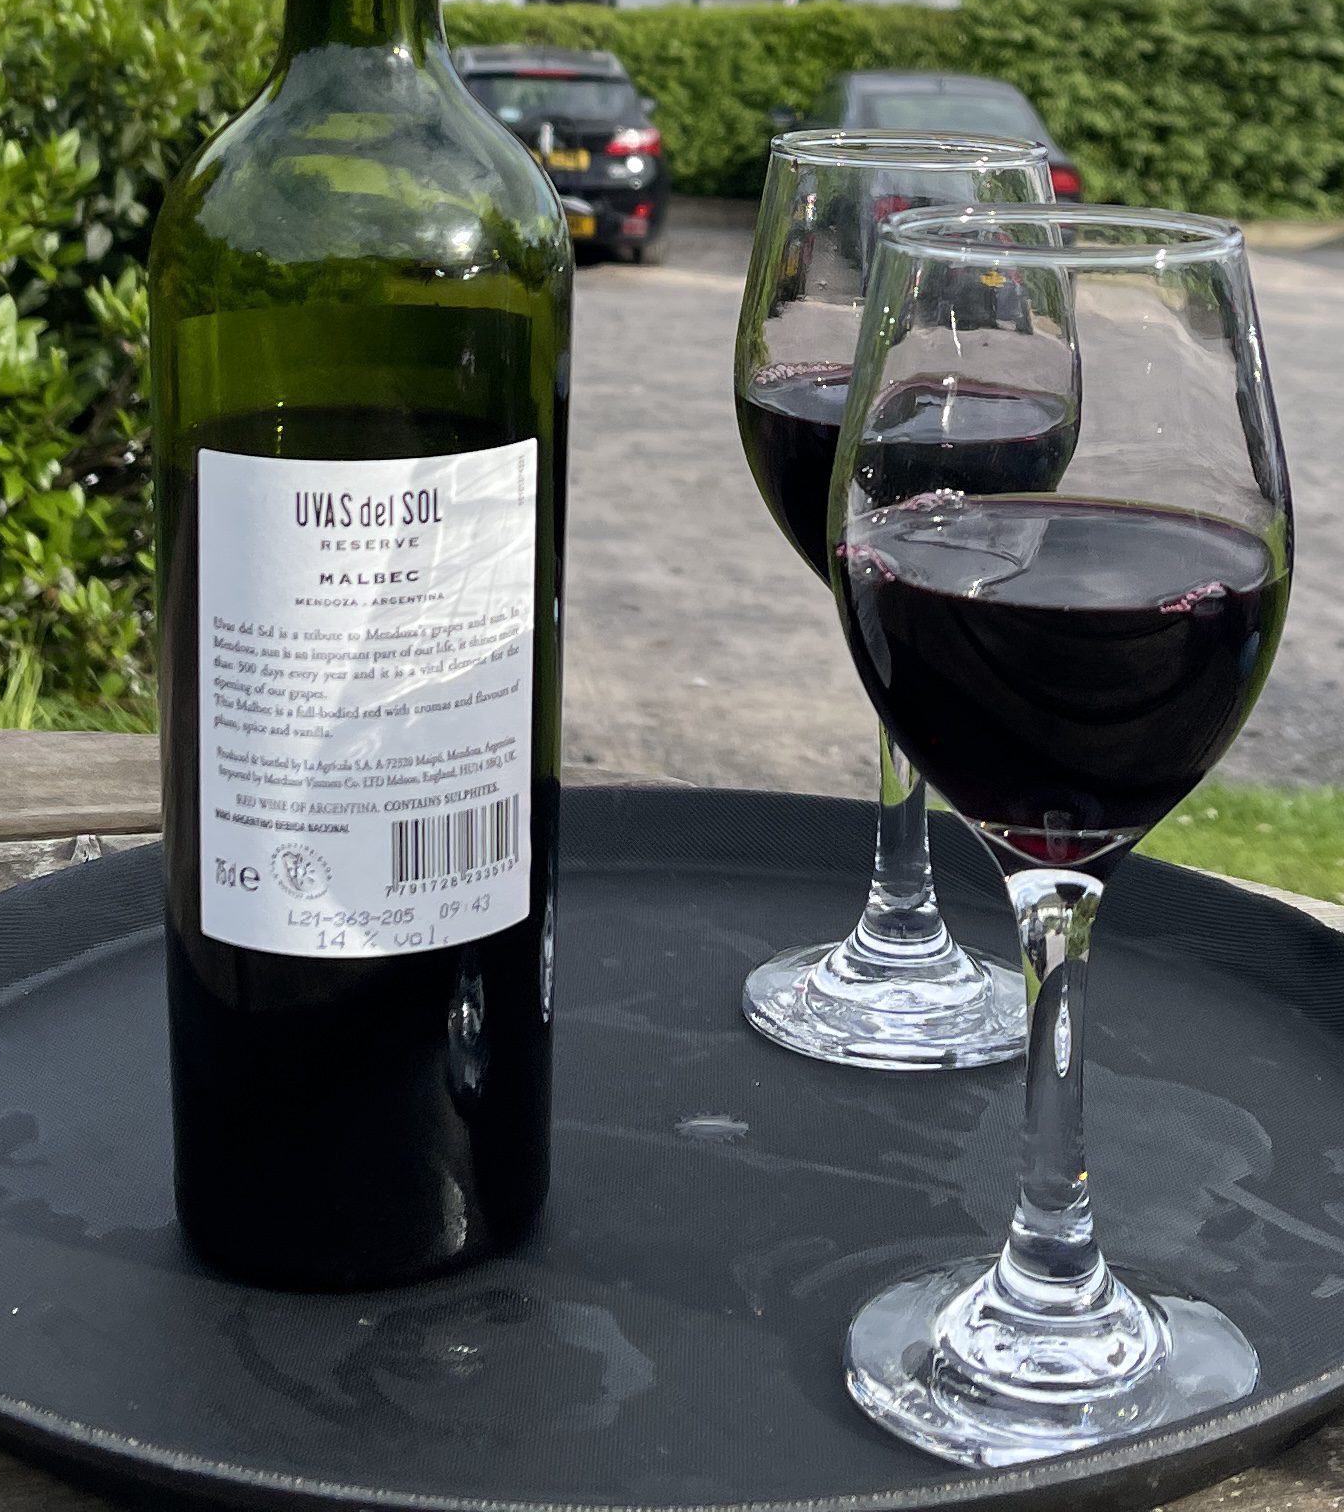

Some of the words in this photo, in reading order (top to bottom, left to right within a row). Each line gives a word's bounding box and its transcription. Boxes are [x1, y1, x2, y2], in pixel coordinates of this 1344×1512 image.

[296, 491, 353, 528] UVAS
[360, 495, 393, 526] del
[403, 488, 442, 525] SOL
[320, 536, 419, 551] RESERVE
[319, 570, 420, 585] MALBEC
[295, 598, 358, 606] MENDOZA
[373, 594, 445, 605] ARGENTINA
[258, 625, 274, 638] Sol
[279, 627, 288, 639] is
[304, 629, 343, 640] tribute
[348, 632, 360, 640] to
[432, 625, 463, 638] grapes
[468, 615, 486, 627] and
[312, 649, 369, 663] important
[374, 650, 396, 662] part
[400, 645, 413, 657] of
[415, 647, 434, 655] our
[469, 635, 496, 647] shines
[260, 664, 284, 679] days
[288, 671, 318, 682] every
[324, 672, 348, 683] year
[353, 670, 374, 679] and
[491, 651, 504, 662] for
[236, 698, 272, 714] Malbec
[296, 705, 358, 718] full-bodied
[415, 701, 450, 713] aromas
[455, 694, 473, 707] and
[511, 679, 520, 692] of
[254, 682, 266, 694] of
[268, 687, 286, 696] our
[289, 690, 327, 701] grapes.
[243, 722, 267, 736] spice
[269, 724, 289, 736] and
[258, 797, 287, 810] WINE
[290, 802, 306, 813] OF
[384, 796, 441, 811] CONTAINS
[445, 782, 499, 804] SULPHITES.
[317, 930, 345, 949] 14
